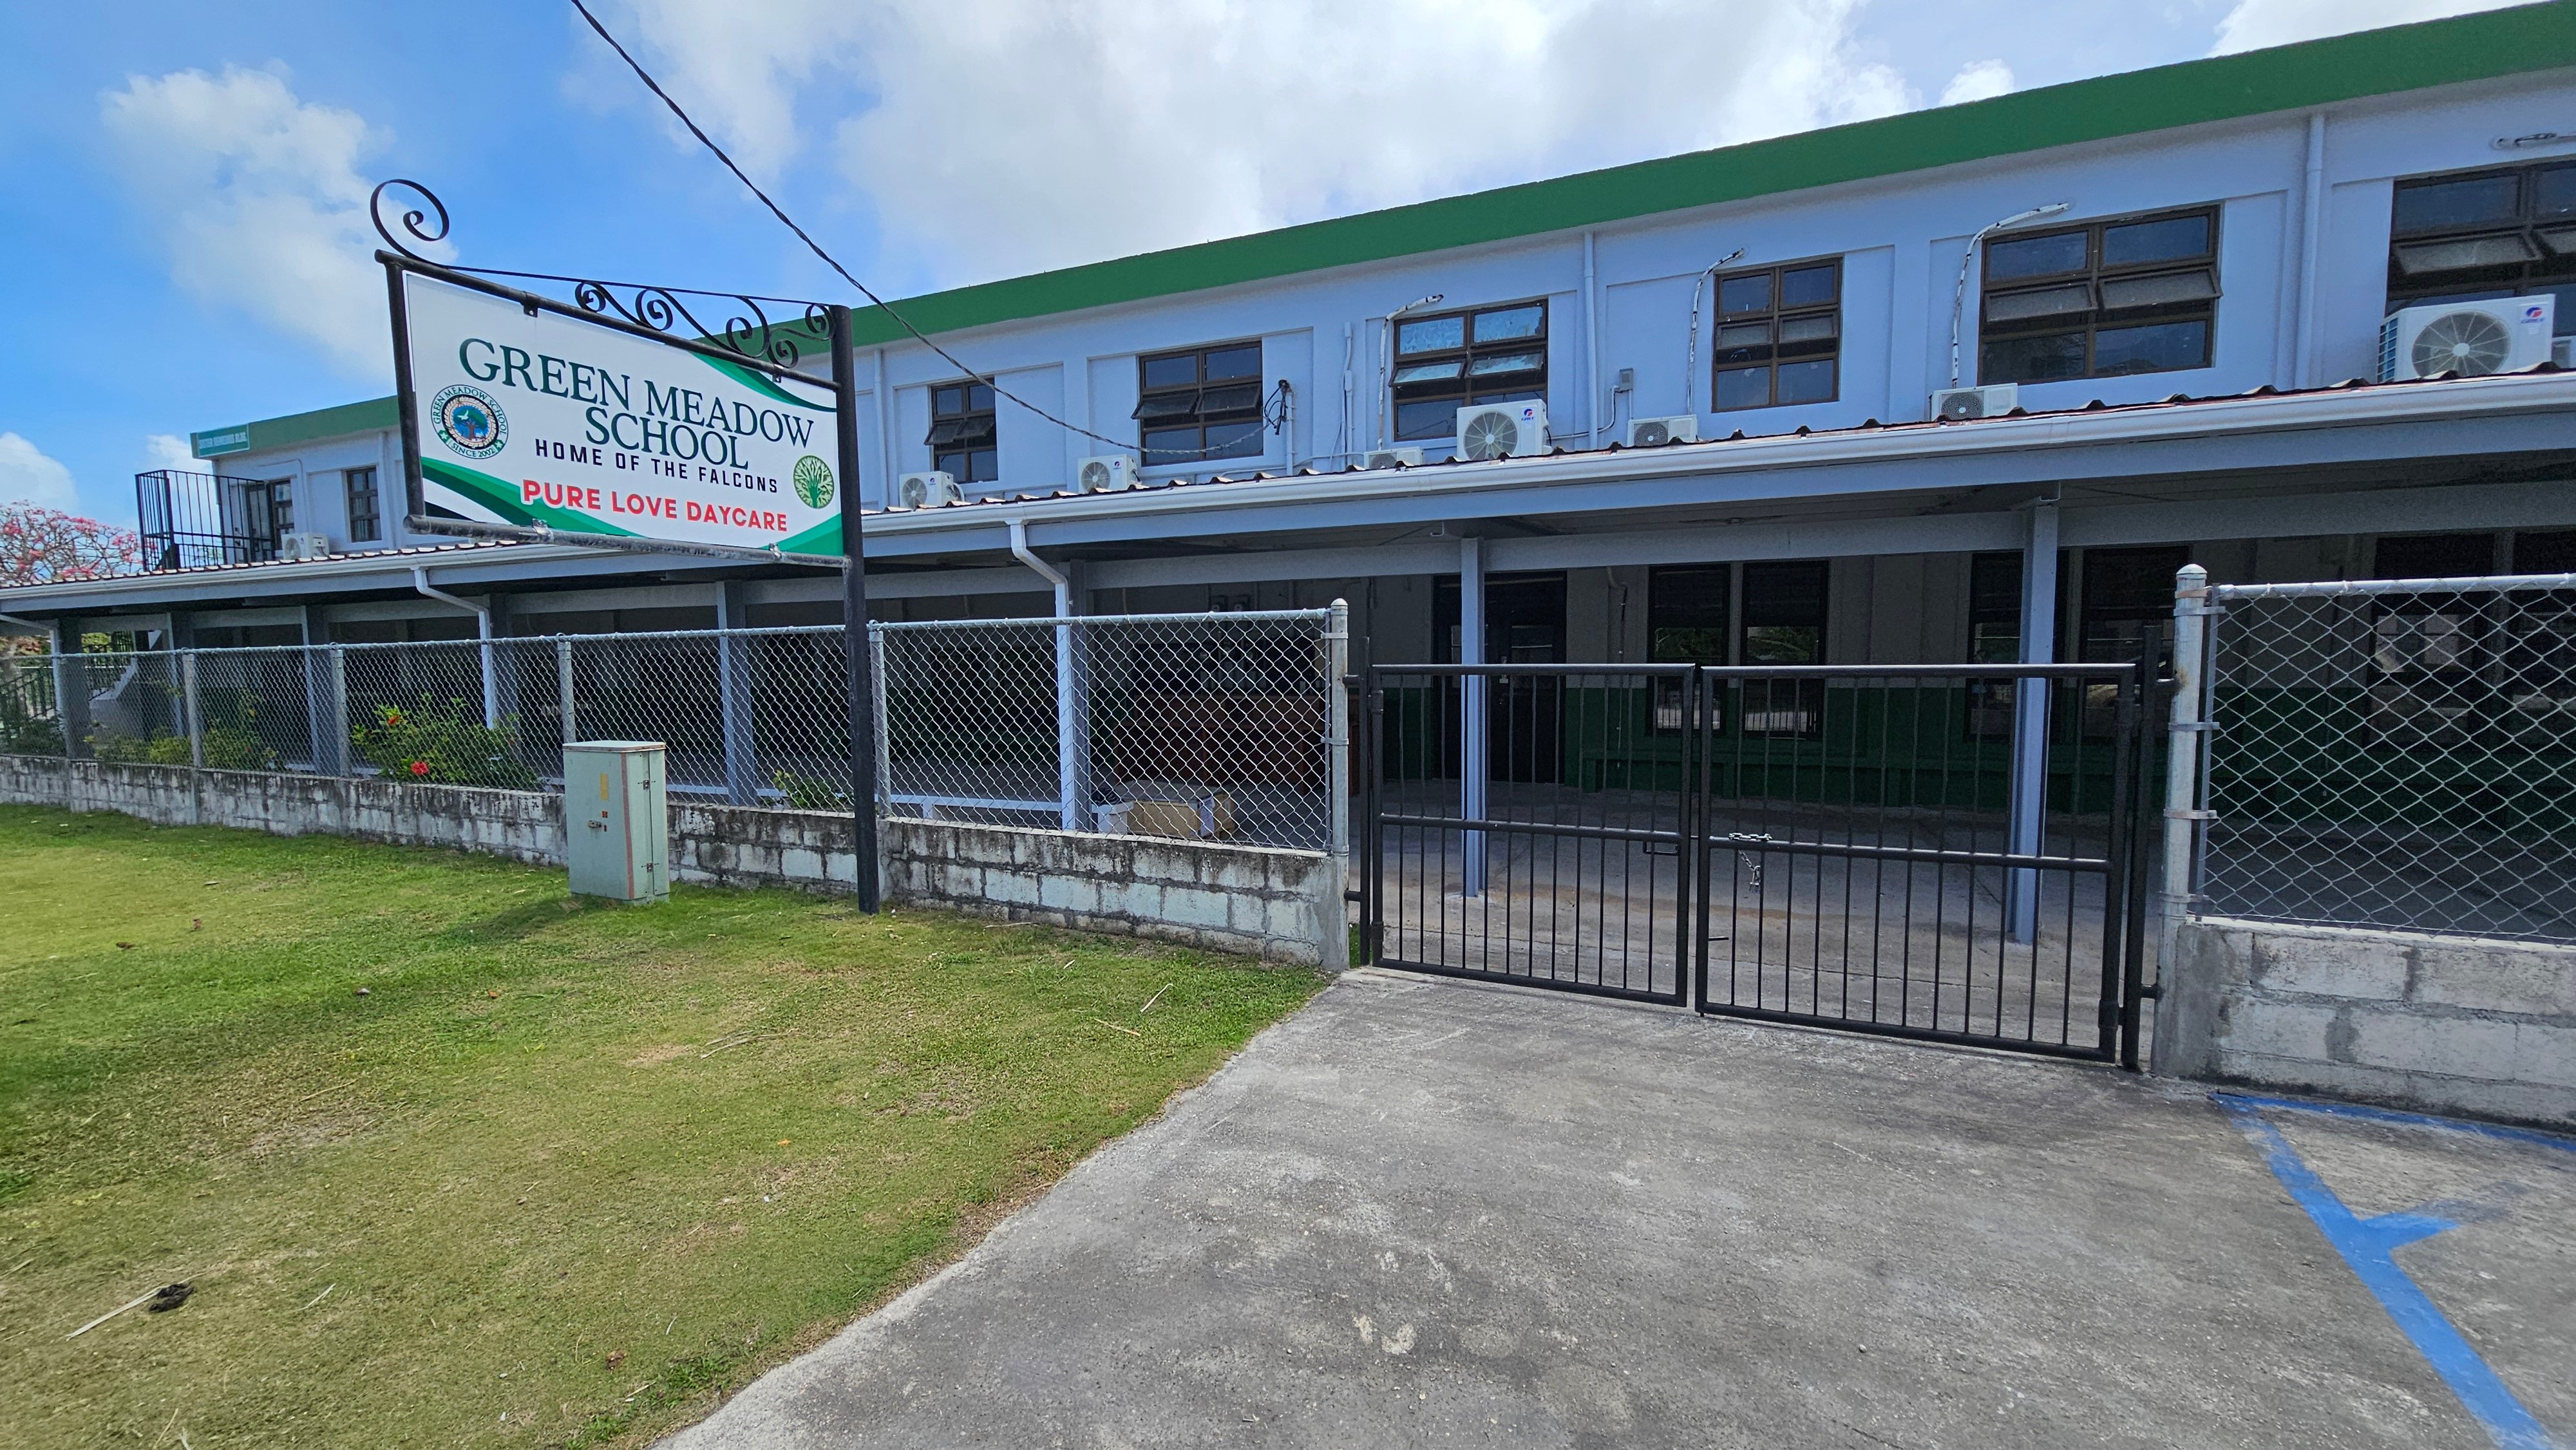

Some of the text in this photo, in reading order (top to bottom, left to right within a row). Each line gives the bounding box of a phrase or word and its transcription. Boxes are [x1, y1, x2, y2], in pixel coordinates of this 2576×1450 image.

[433, 386, 507, 435] GREEN MEADOW SCHOOL
[459, 338, 814, 449] GREEN MEADOW
[451, 442, 495, 457] SINCE 2002
[585, 406, 748, 470] SCHOOL
[535, 438, 777, 493] HOME OF THE FALCONS
[522, 478, 788, 532] PURE LOVE DAYCARE
